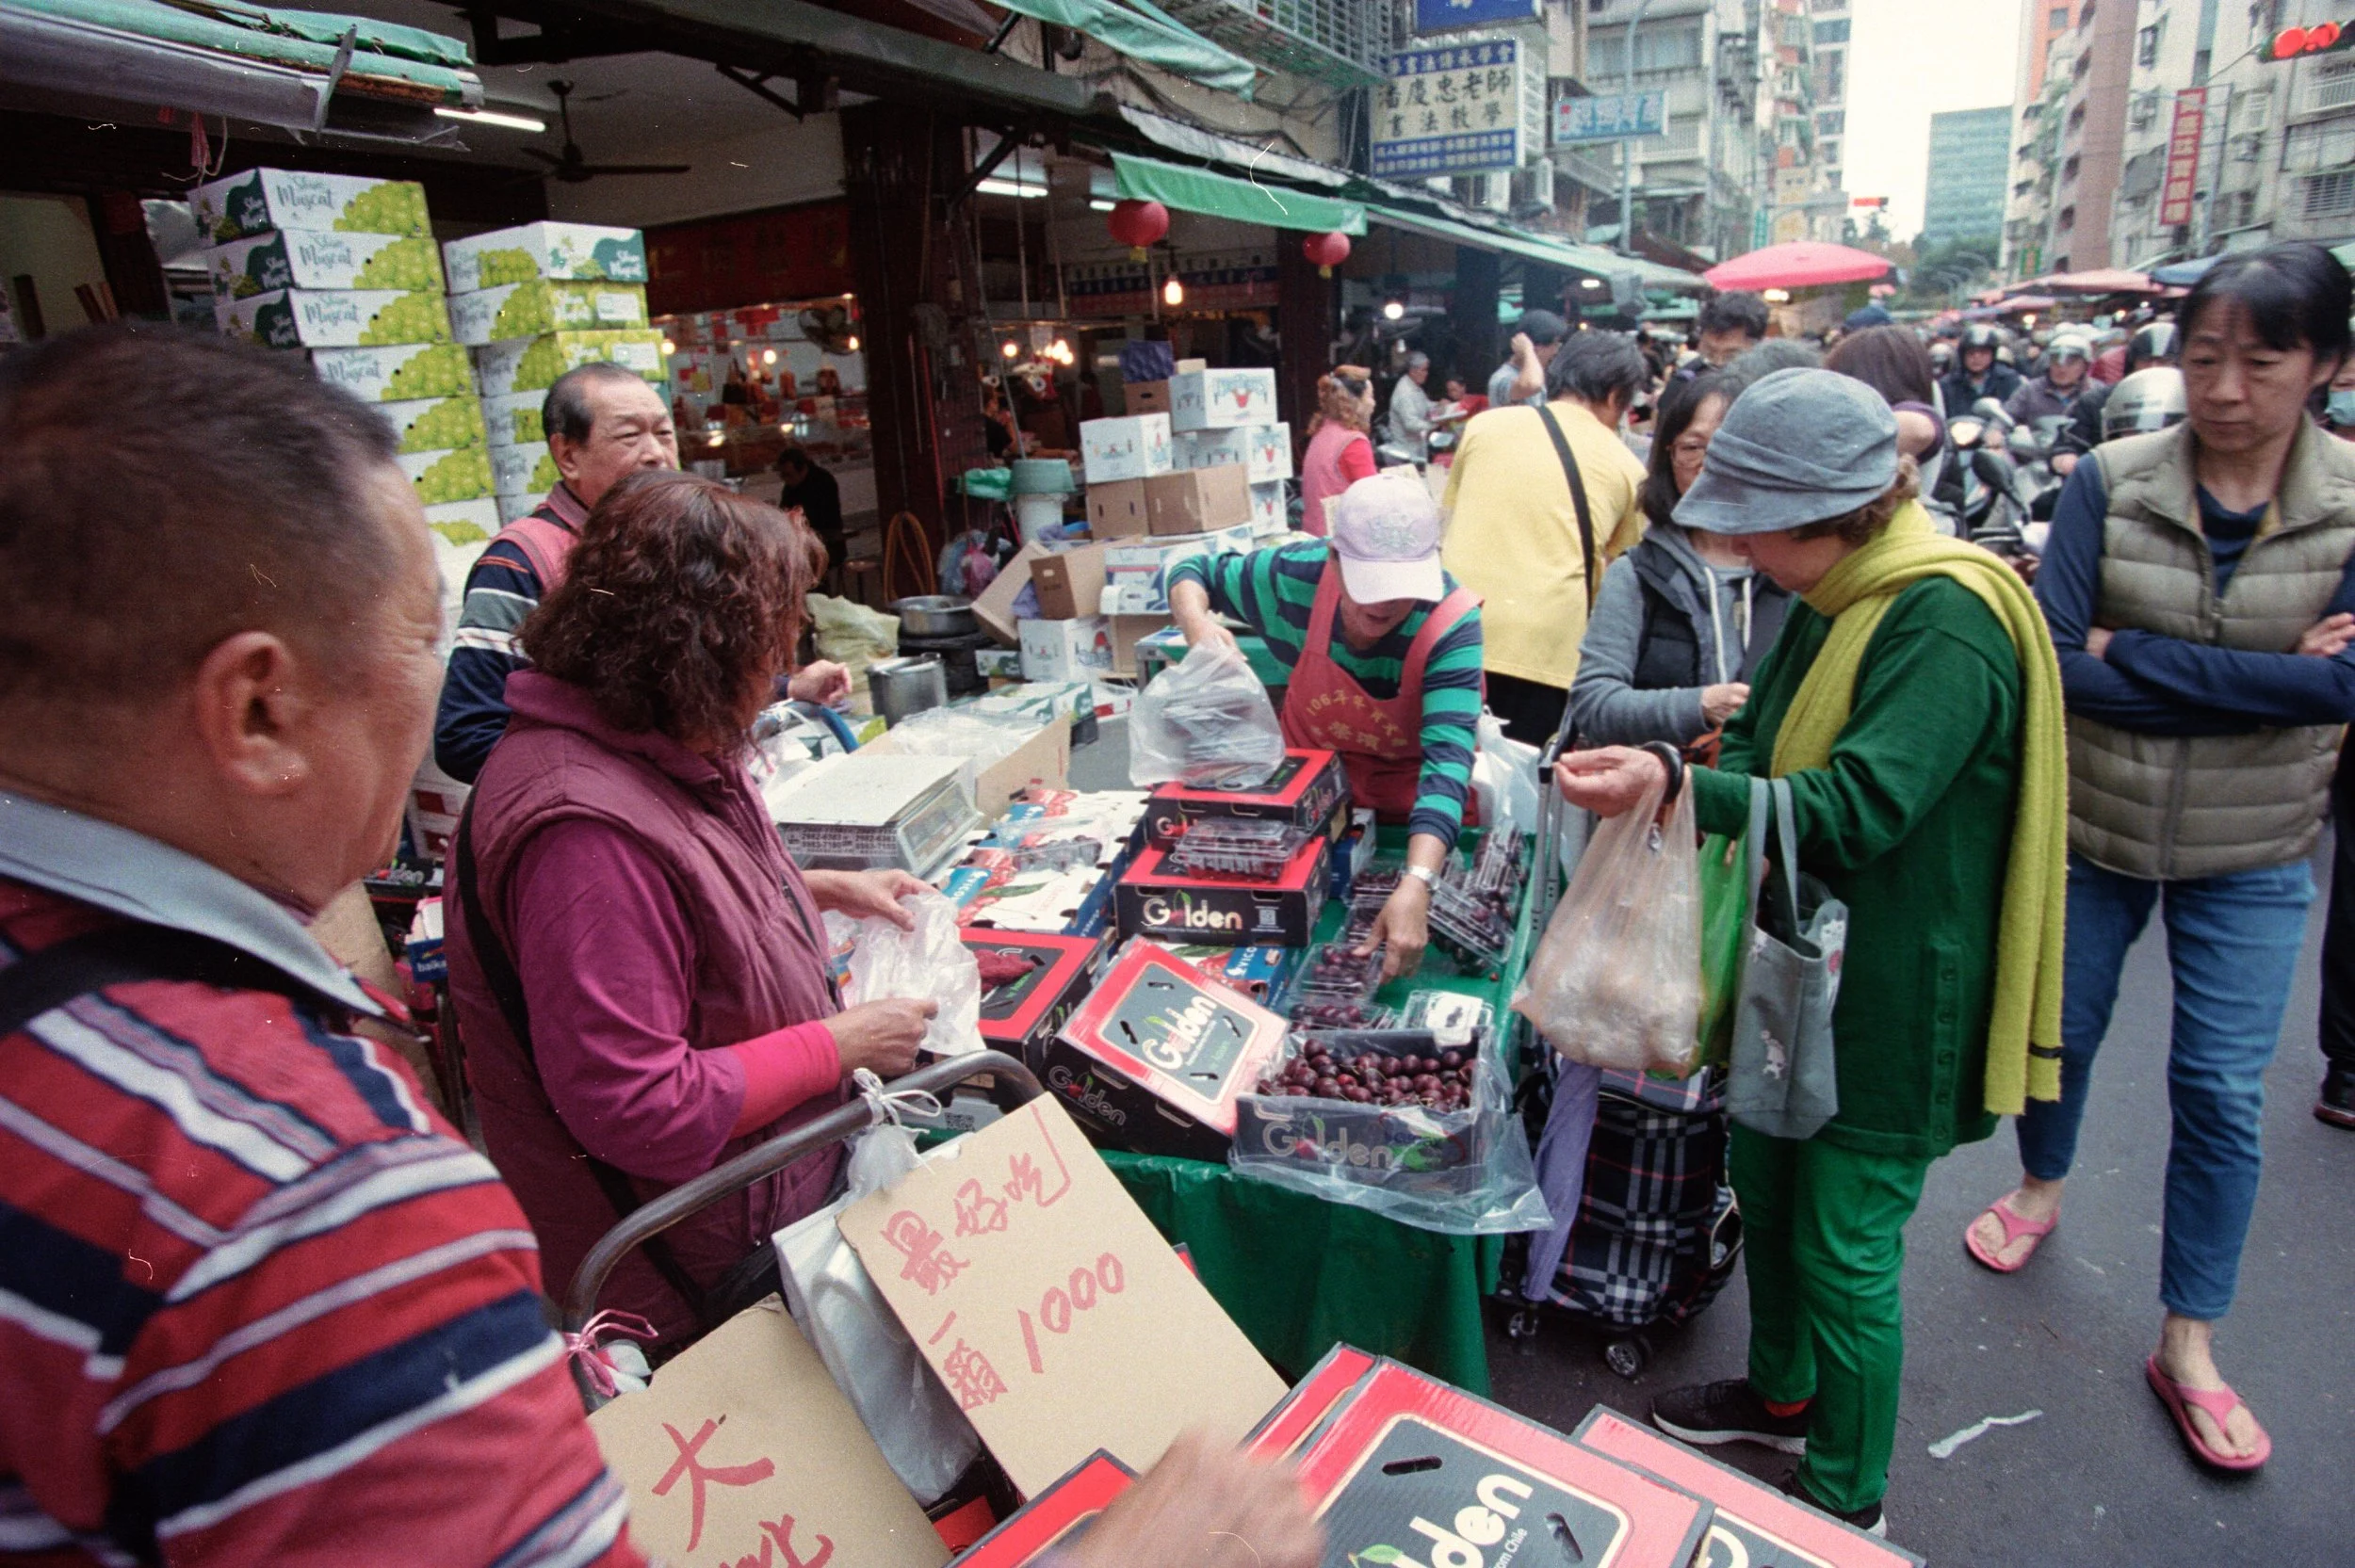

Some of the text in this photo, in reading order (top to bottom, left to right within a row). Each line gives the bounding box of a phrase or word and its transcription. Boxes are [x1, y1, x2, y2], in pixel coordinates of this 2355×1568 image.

[1141, 895, 1243, 929] Golden
[1142, 995, 1218, 1070] Golden
[1048, 1065, 1128, 1126] Golden
[1261, 1120, 1395, 1169] Golden
[880, 1104, 1072, 1296] 最好吃
[1017, 1252, 1125, 1374] 1000
[1504, 1528, 1528, 1554] Chile
